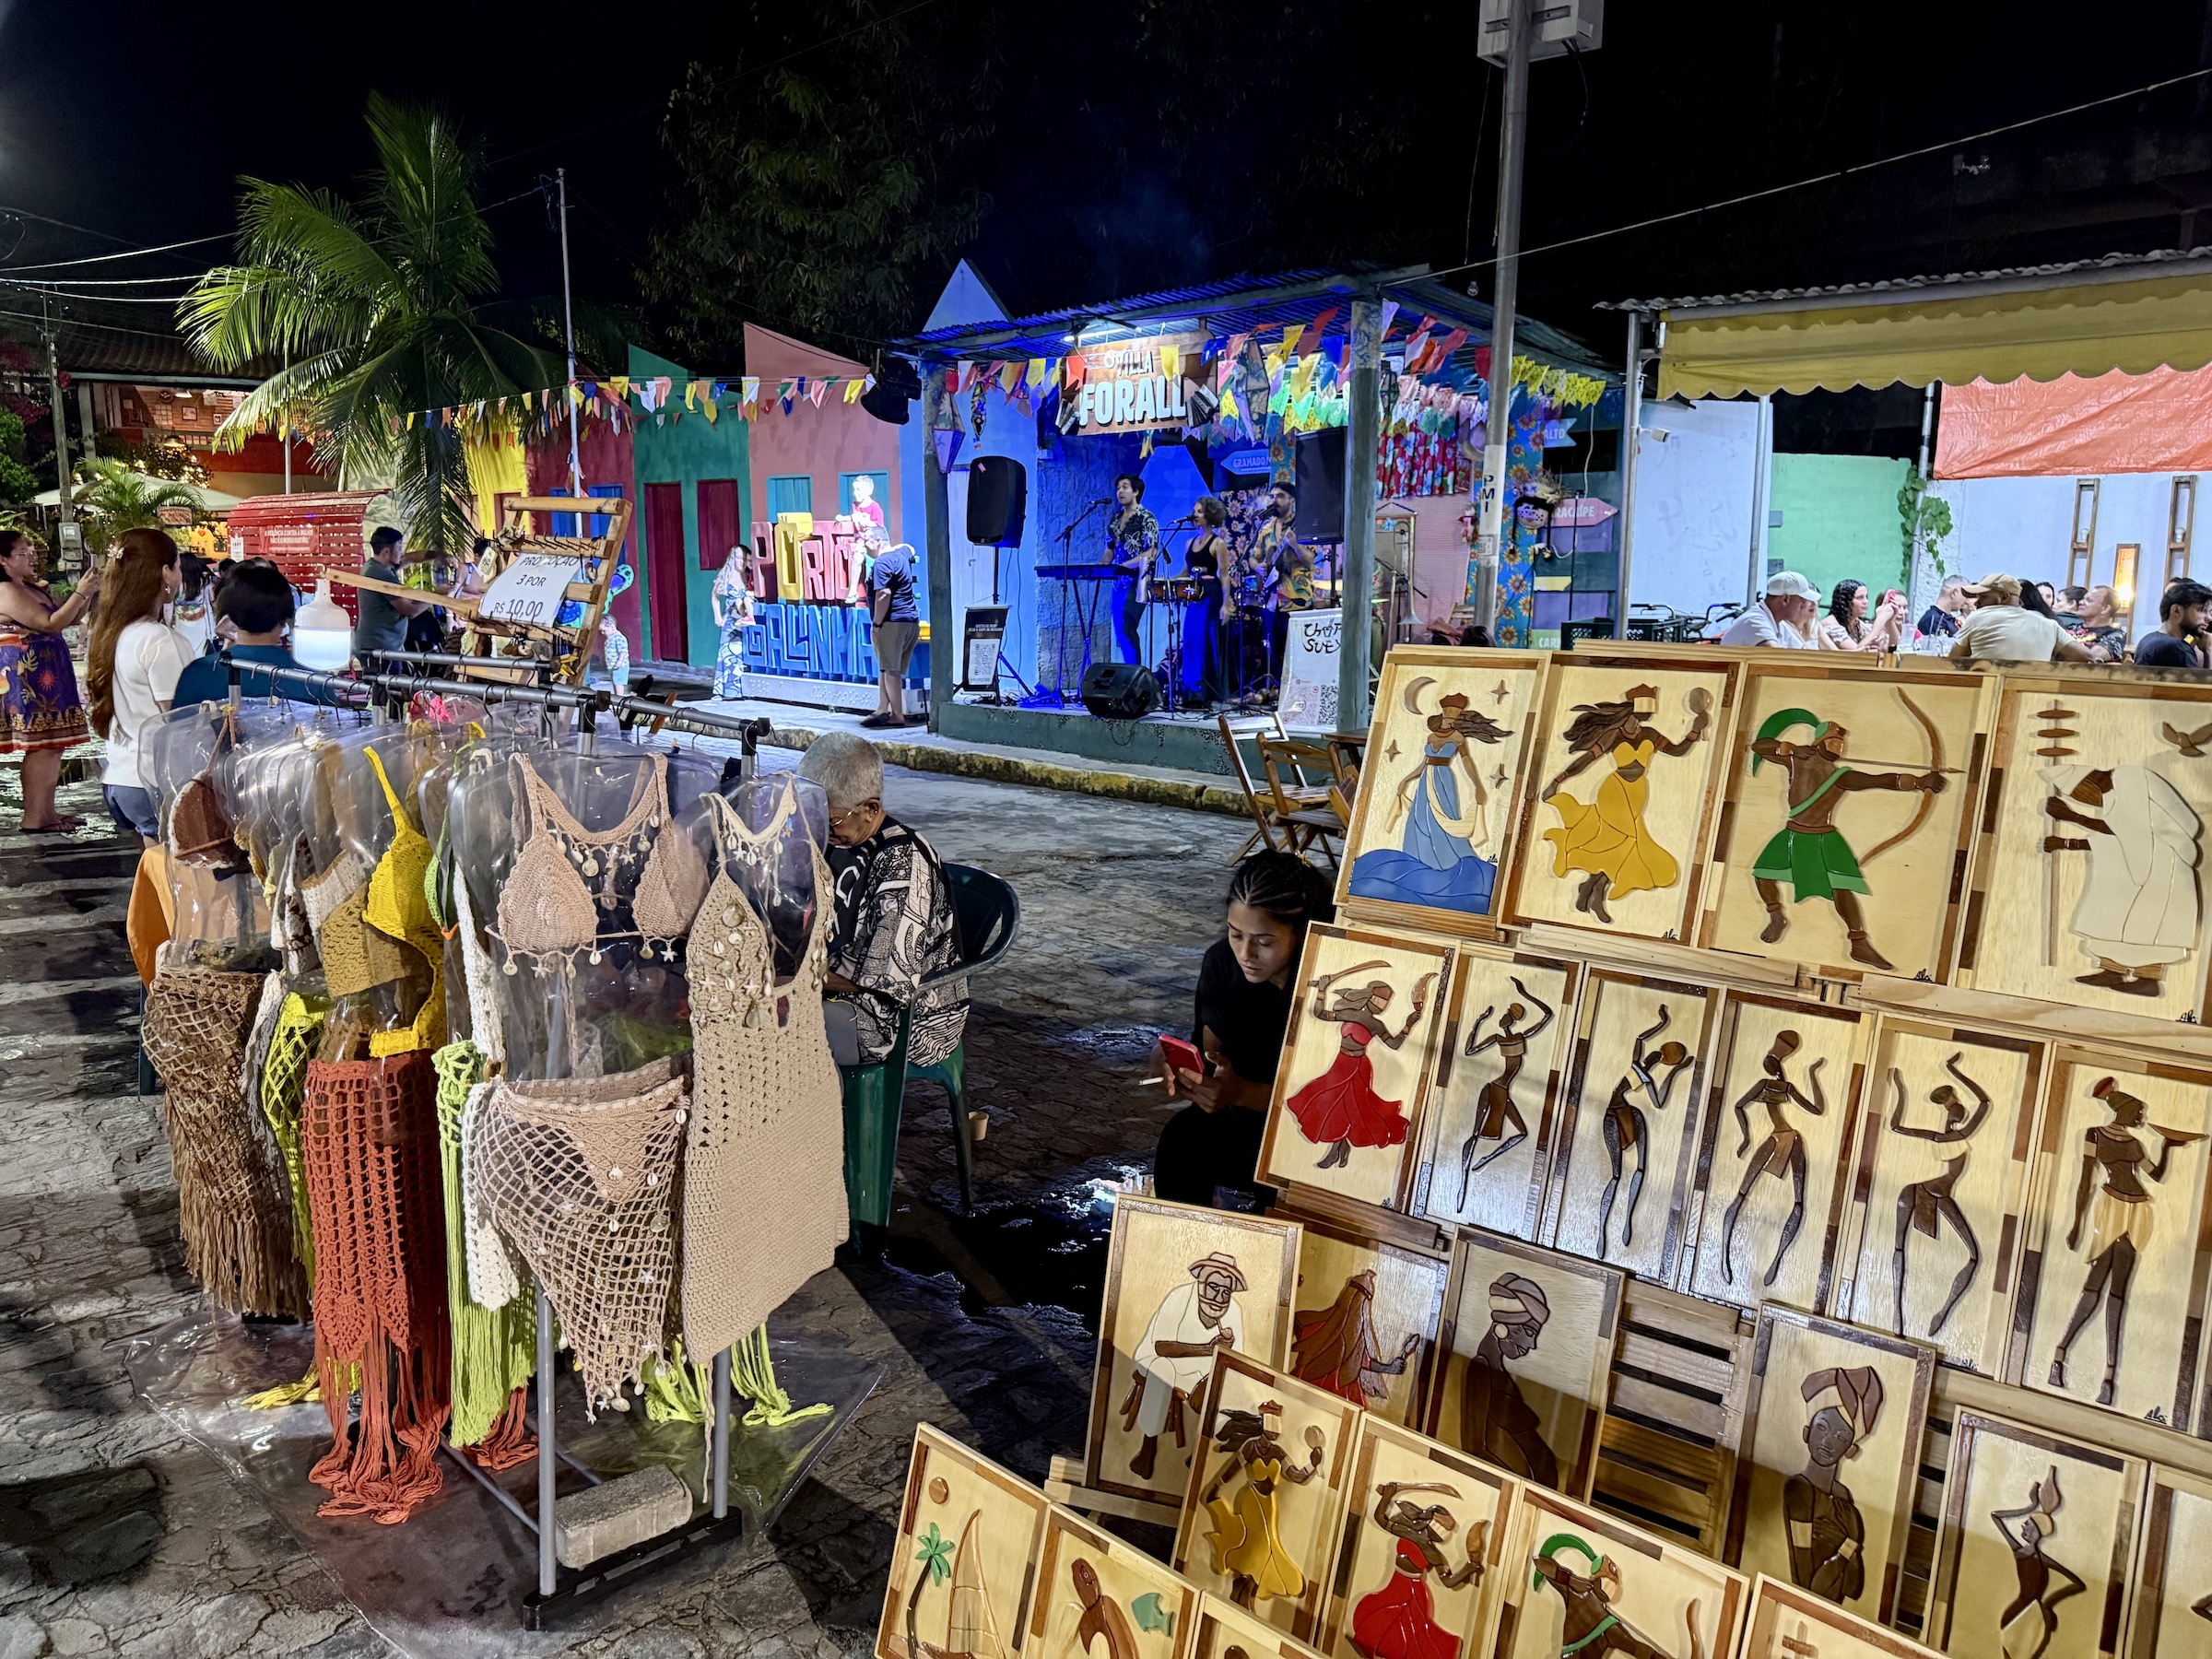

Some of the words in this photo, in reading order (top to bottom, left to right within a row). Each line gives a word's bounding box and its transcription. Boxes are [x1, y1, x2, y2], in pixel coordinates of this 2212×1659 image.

[1078, 373, 1187, 427] FORALL
[1554, 503, 1594, 518] RACAÍPE
[751, 512, 855, 601] PORTO
[516, 574, 527, 585] 3
[524, 577, 547, 587] POR
[493, 601, 505, 615] R$
[506, 598, 544, 618] 10,00
[742, 602, 880, 677] GALINHA
